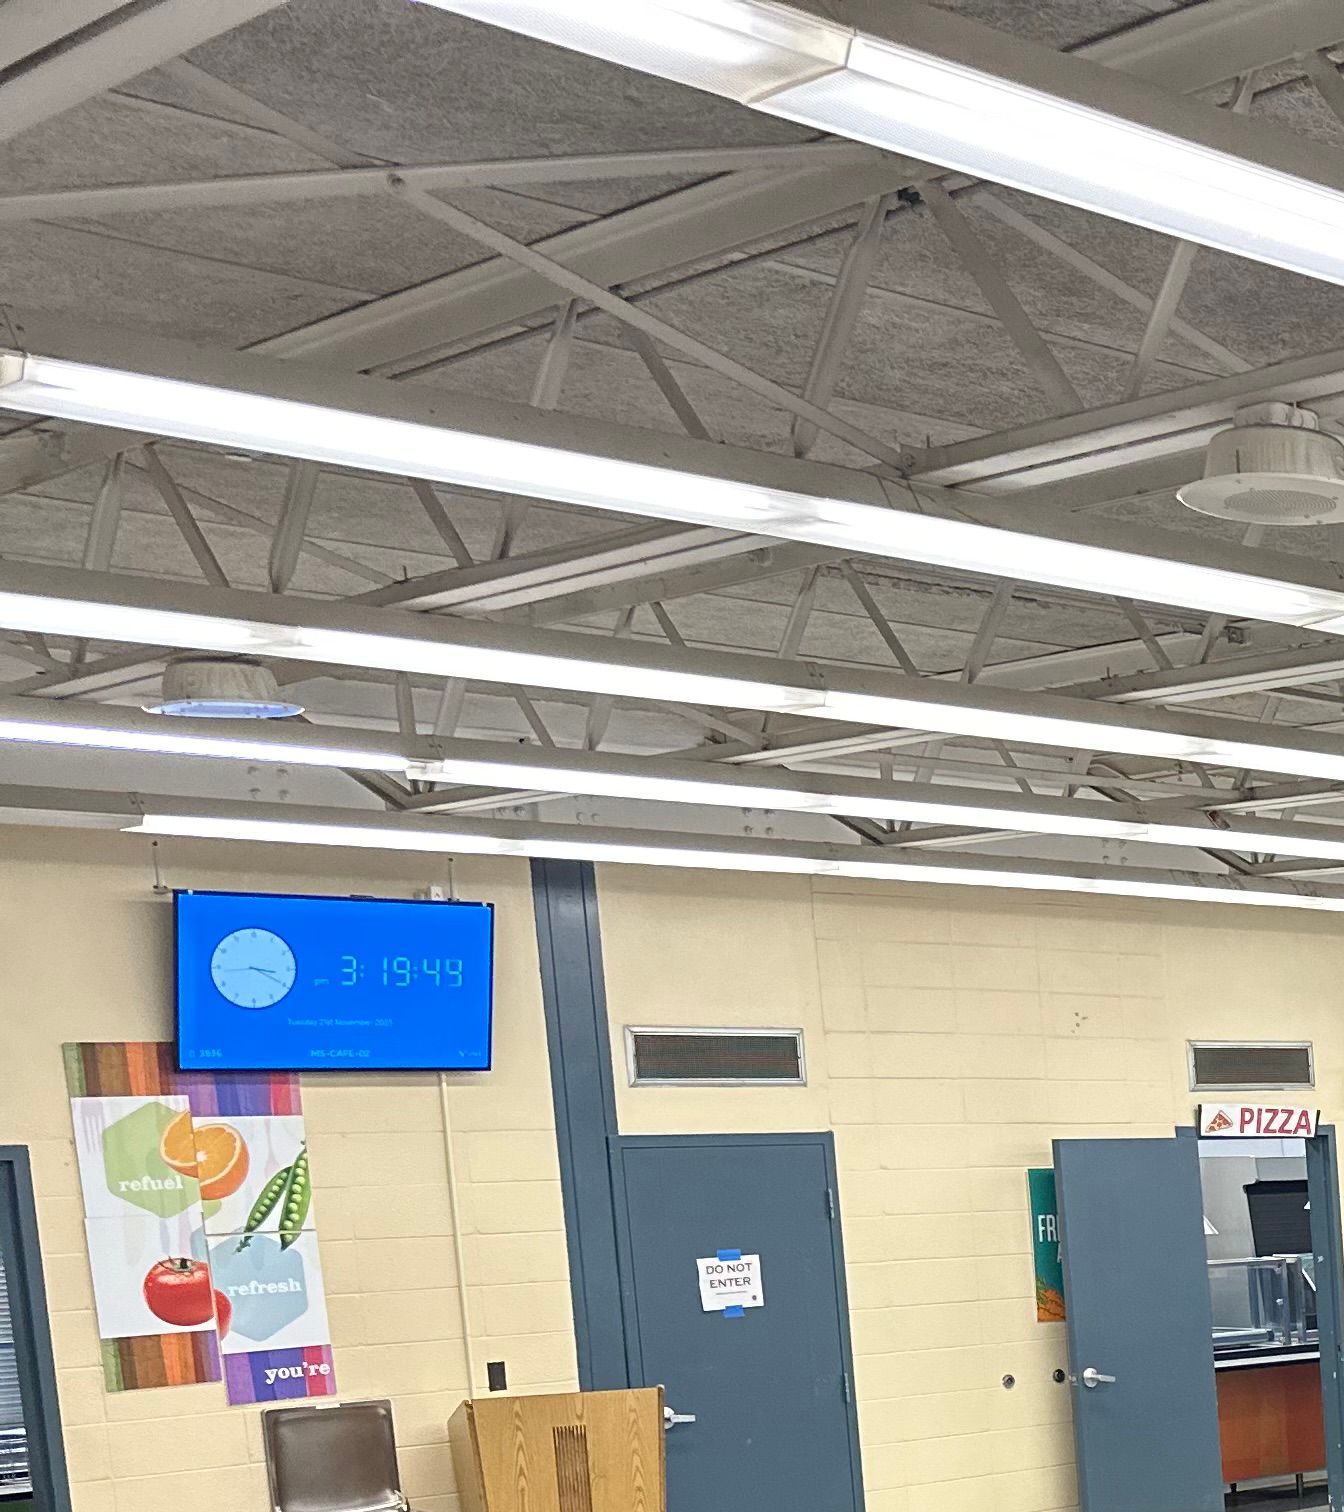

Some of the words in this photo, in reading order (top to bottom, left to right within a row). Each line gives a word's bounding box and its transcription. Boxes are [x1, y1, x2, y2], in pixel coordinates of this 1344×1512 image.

[1239, 1107, 1312, 1135] PIZZA
[118, 1174, 184, 1193] refuel
[705, 1264, 724, 1275] DO
[726, 1262, 752, 1273] NOT
[227, 1277, 303, 1298] refresh
[709, 1276, 751, 1289] ENTER
[264, 1360, 332, 1386] you're
